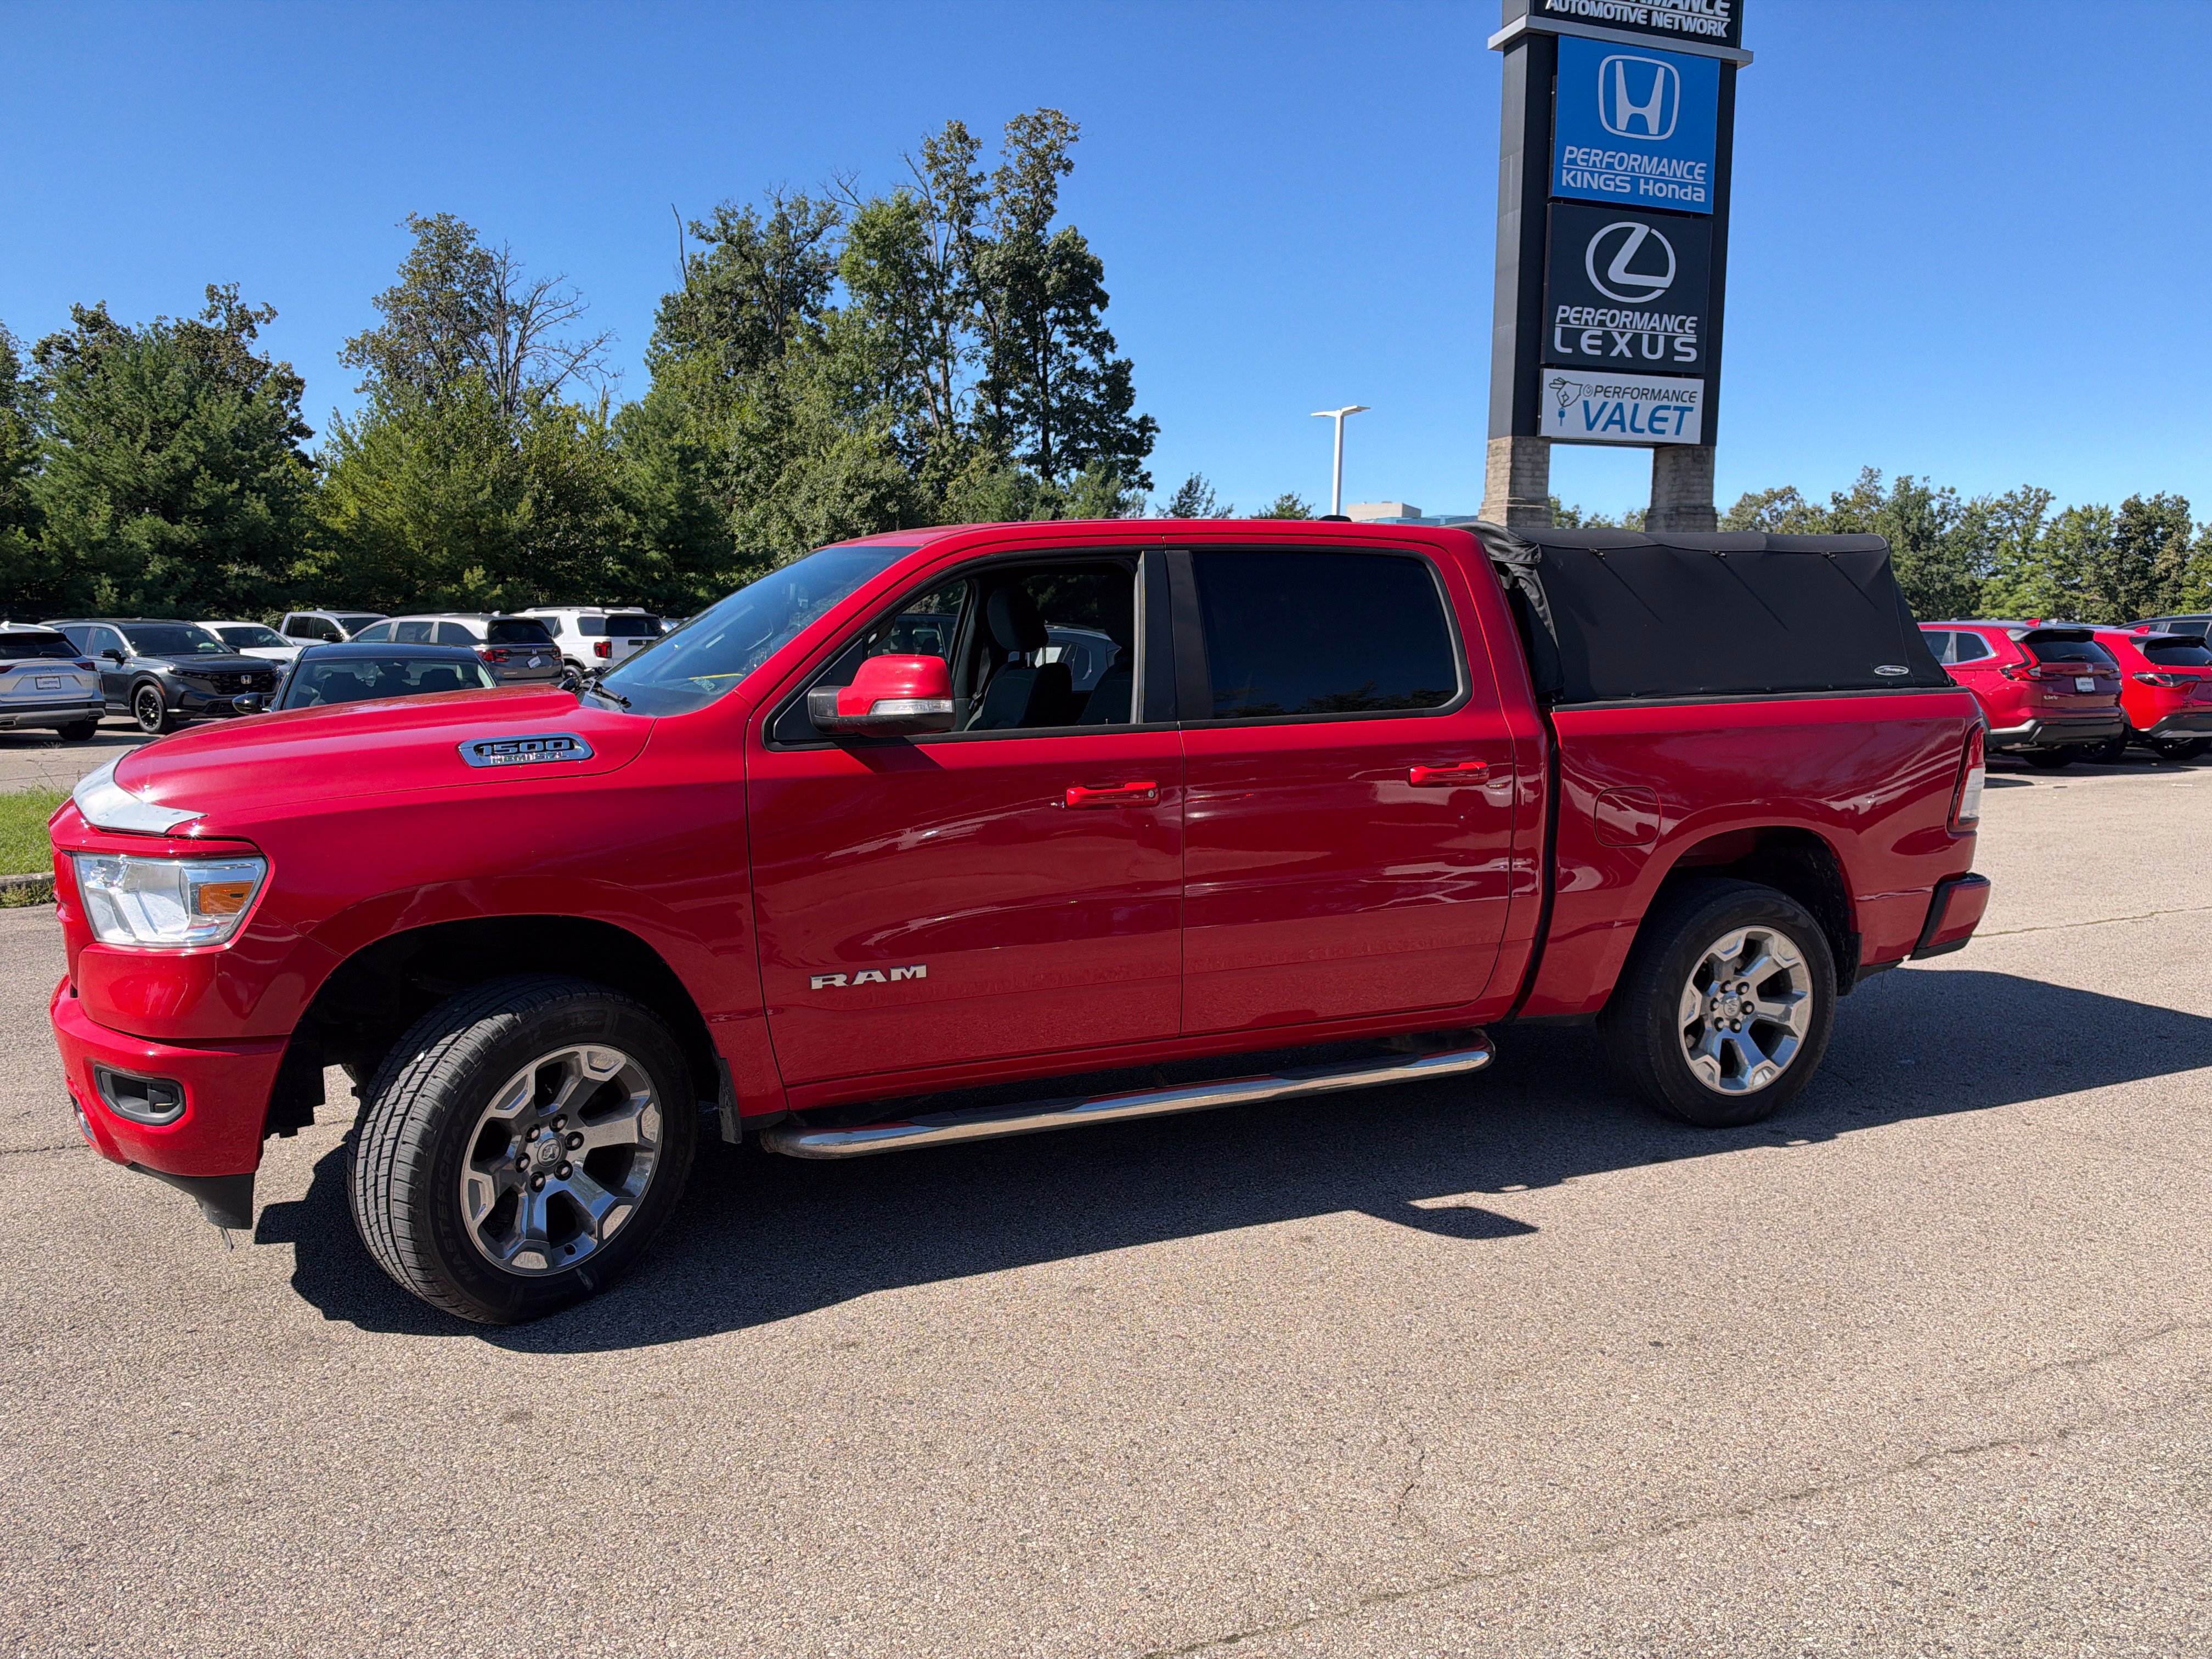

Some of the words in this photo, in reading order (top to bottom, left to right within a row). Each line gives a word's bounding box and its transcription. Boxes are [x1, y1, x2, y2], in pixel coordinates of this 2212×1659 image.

[1545, 0, 1647, 25] AUTOMOTIVE
[1651, 11, 1728, 37] NETWORK
[1563, 145, 1707, 182] PERFORMANCE
[1562, 169, 1631, 193] KINGS
[1639, 178, 1705, 202] Honda
[1555, 304, 1698, 334] PERFORMANCE
[1554, 326, 1697, 362] LEXUS
[1592, 385, 1697, 403] PERFORMANCE
[1582, 400, 1694, 436] VALET
[478, 740, 570, 757] 1500
[810, 964, 927, 990] RAM
